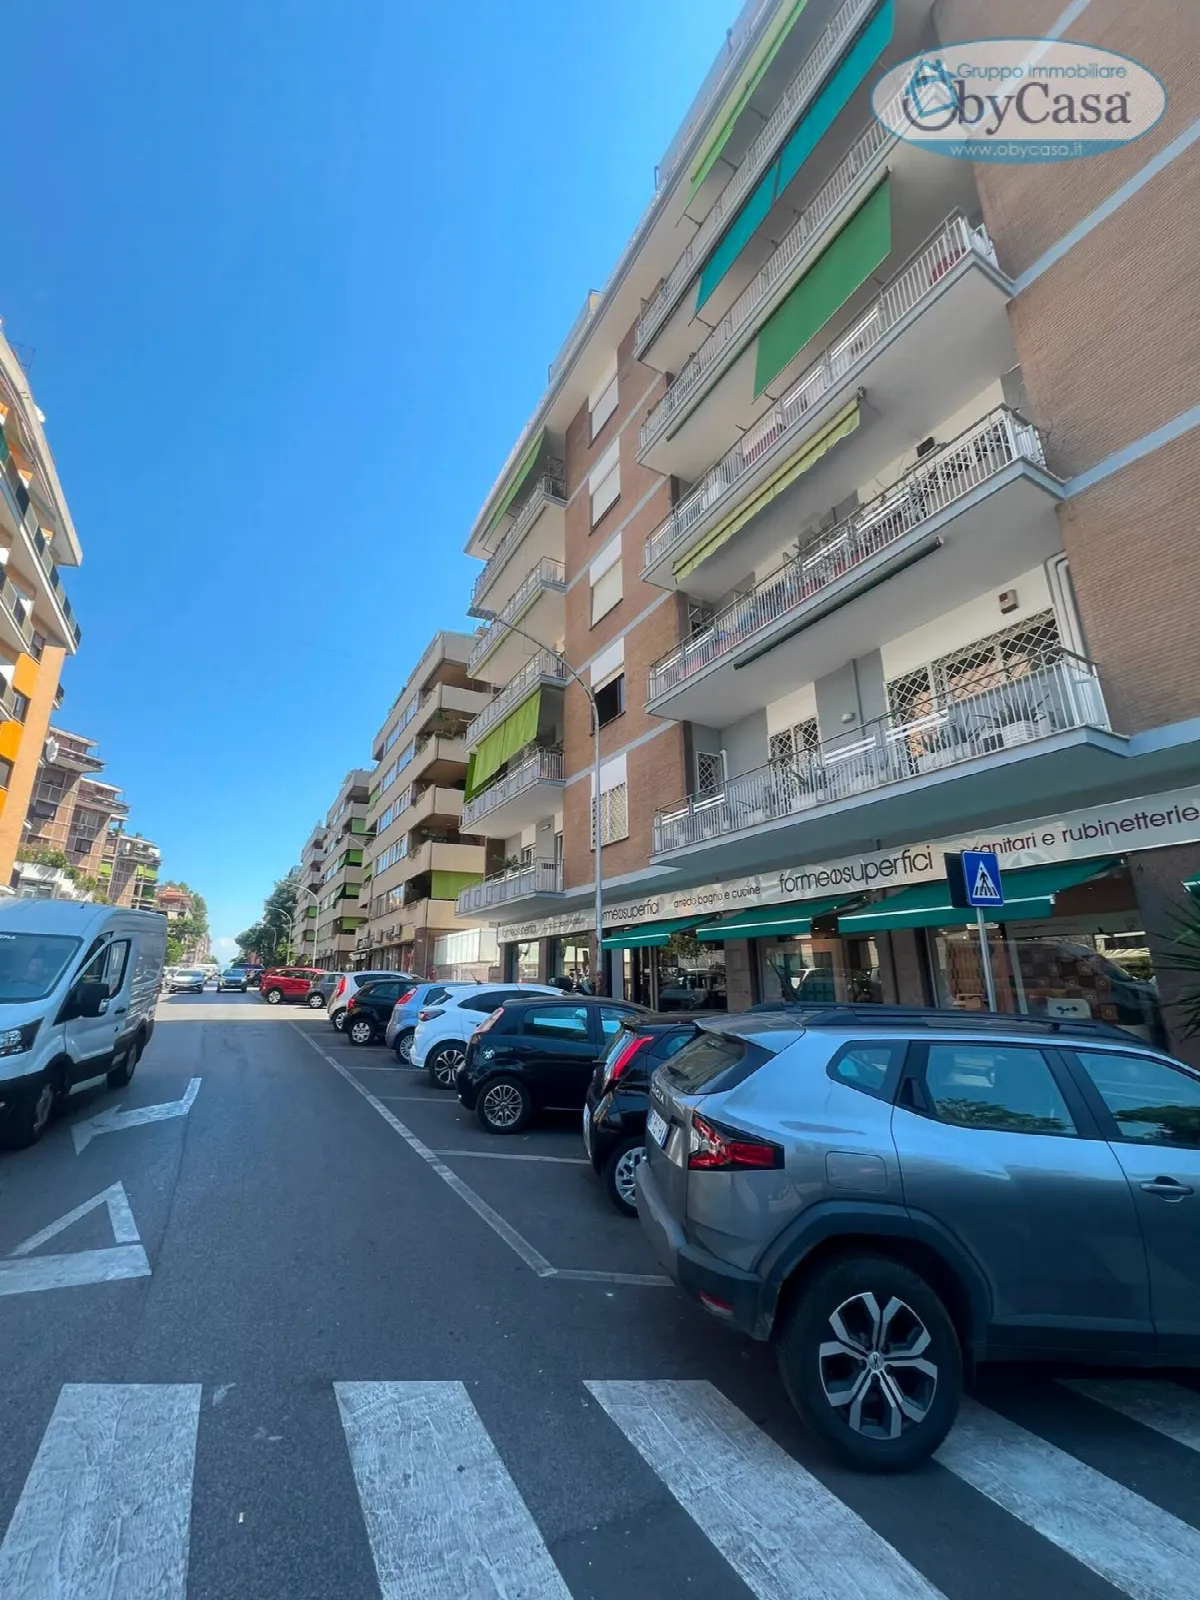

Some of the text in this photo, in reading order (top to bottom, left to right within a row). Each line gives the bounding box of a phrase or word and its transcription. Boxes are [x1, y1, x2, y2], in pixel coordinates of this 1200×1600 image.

[1042, 833, 1055, 846] e
[1062, 805, 1200, 842] rubinetterie
[724, 891, 730, 899] e
